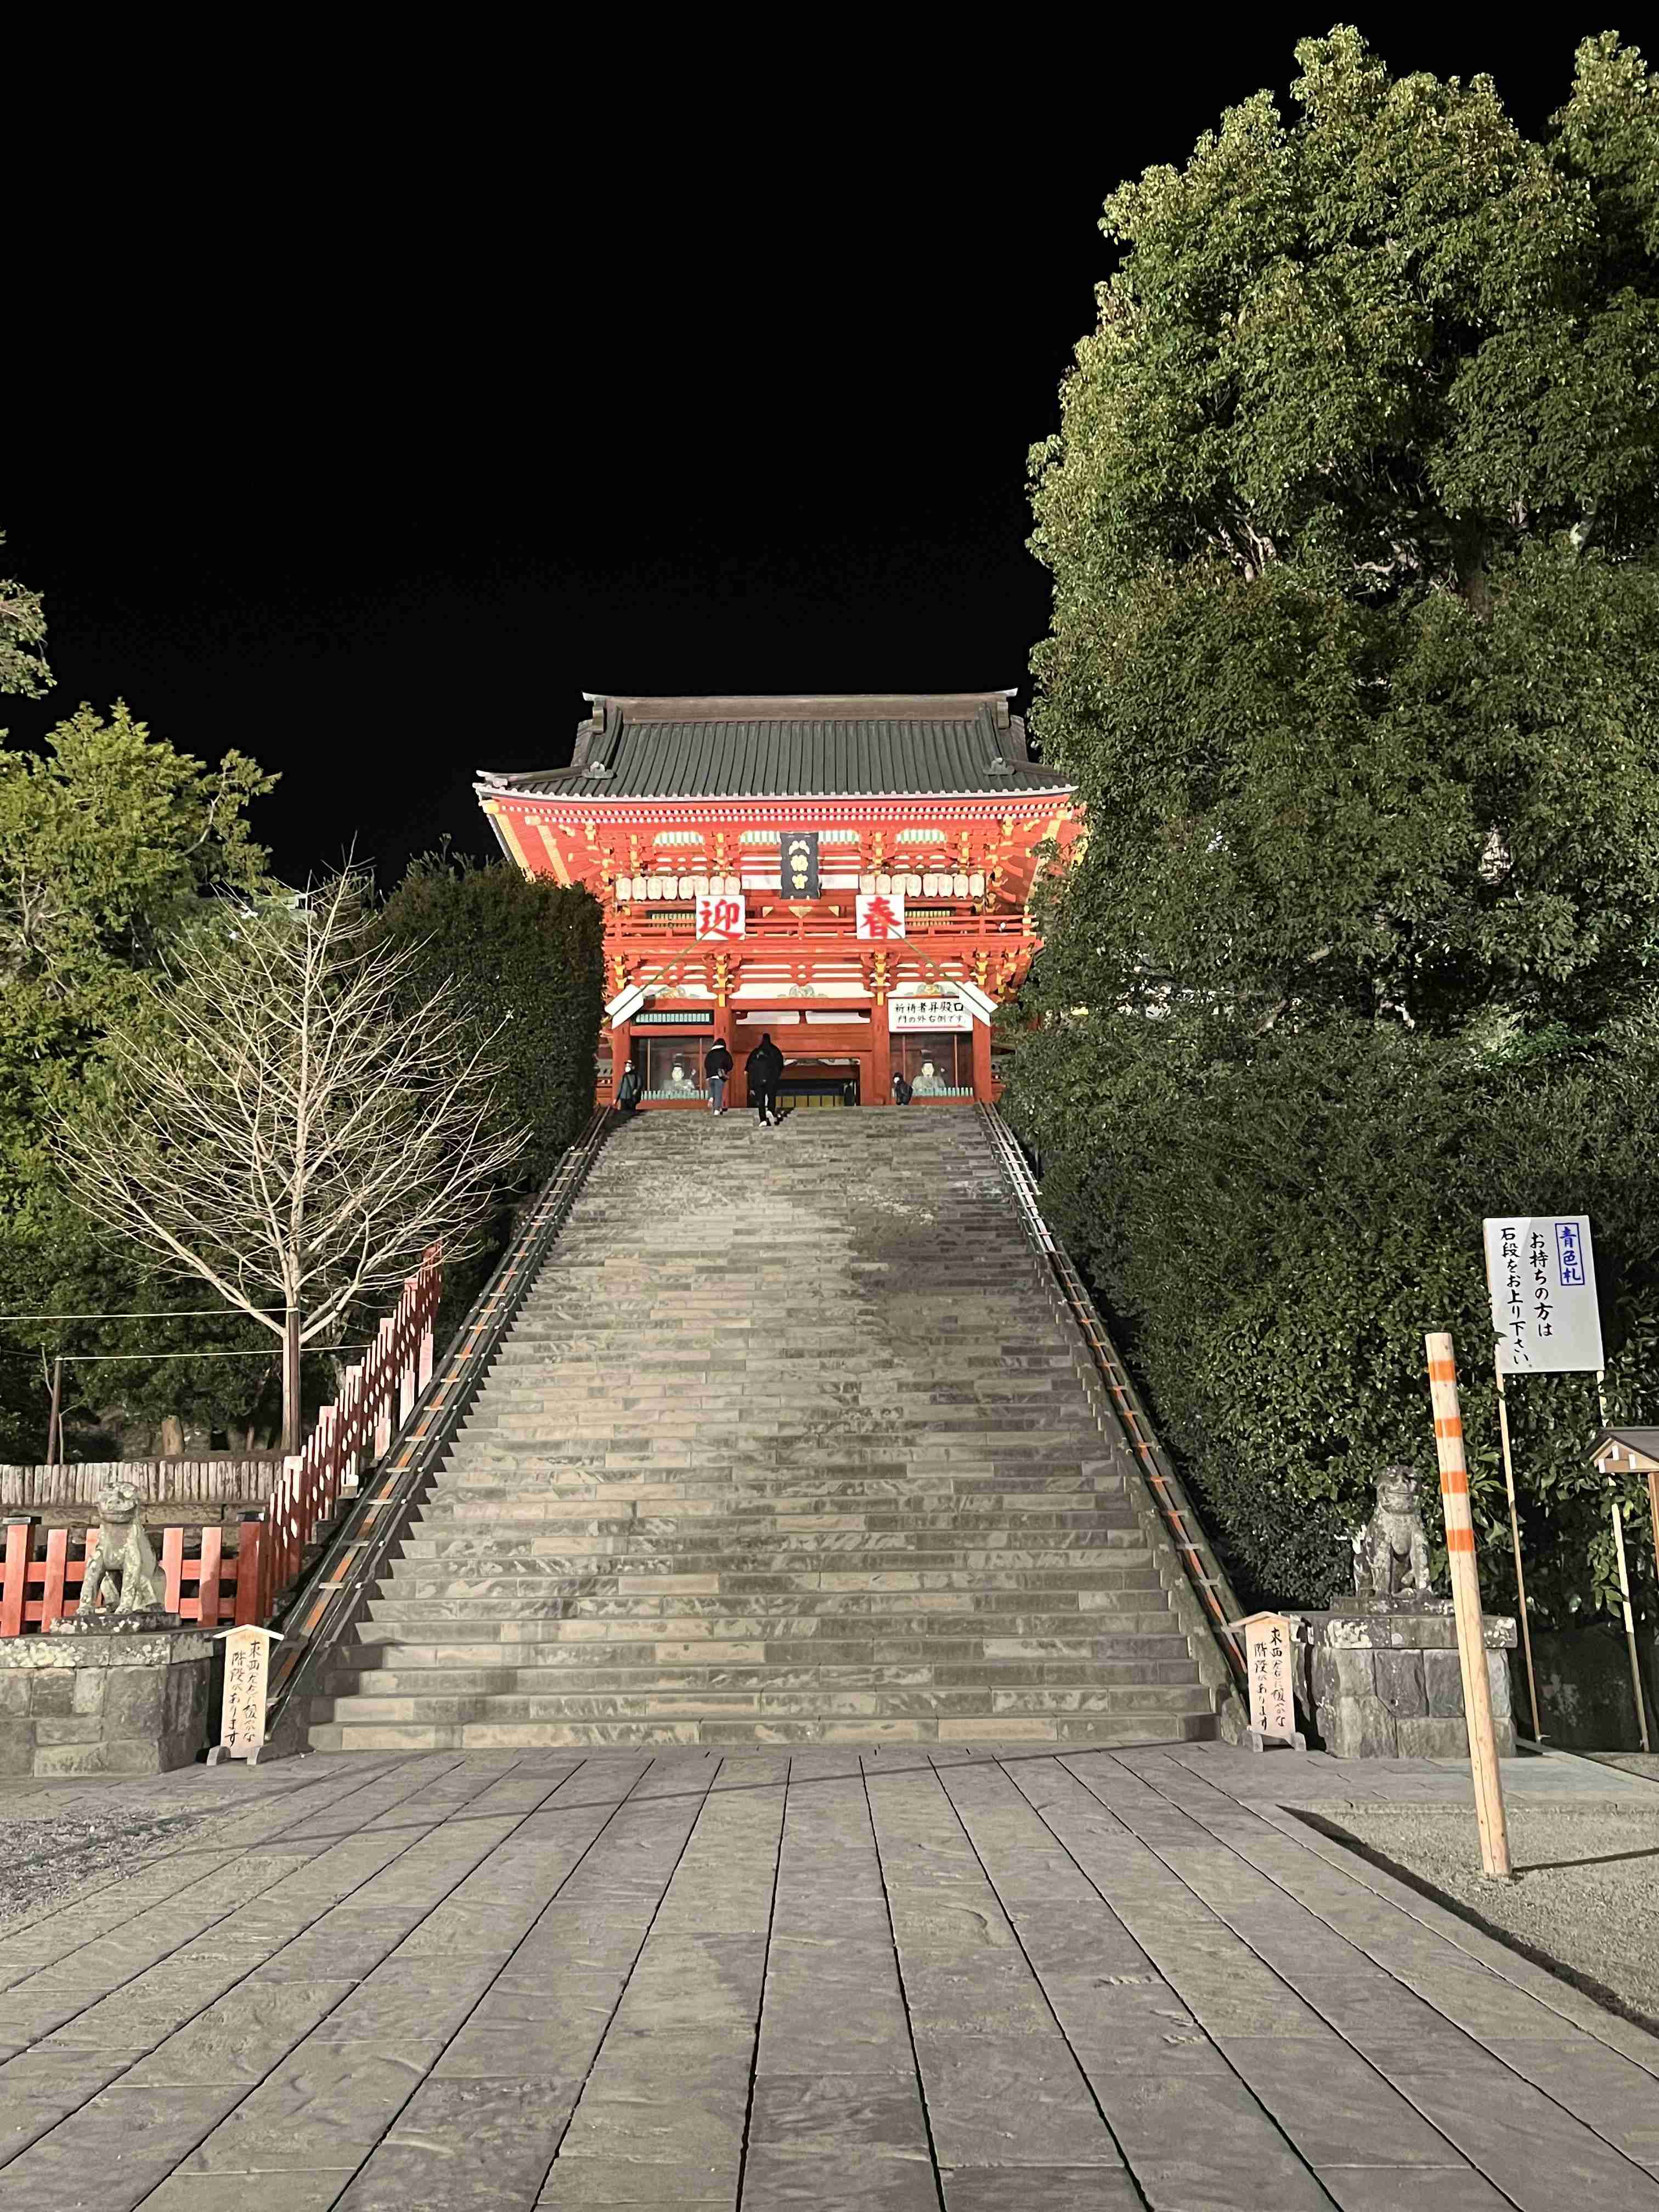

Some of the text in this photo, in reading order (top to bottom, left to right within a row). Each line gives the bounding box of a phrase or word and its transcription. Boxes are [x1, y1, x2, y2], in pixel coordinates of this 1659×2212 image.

[699, 899, 744, 939] 迎
[860, 896, 902, 938] 春
[1560, 1226, 1581, 1283] 青色札
[1529, 1232, 1554, 1337] お持ちの方は
